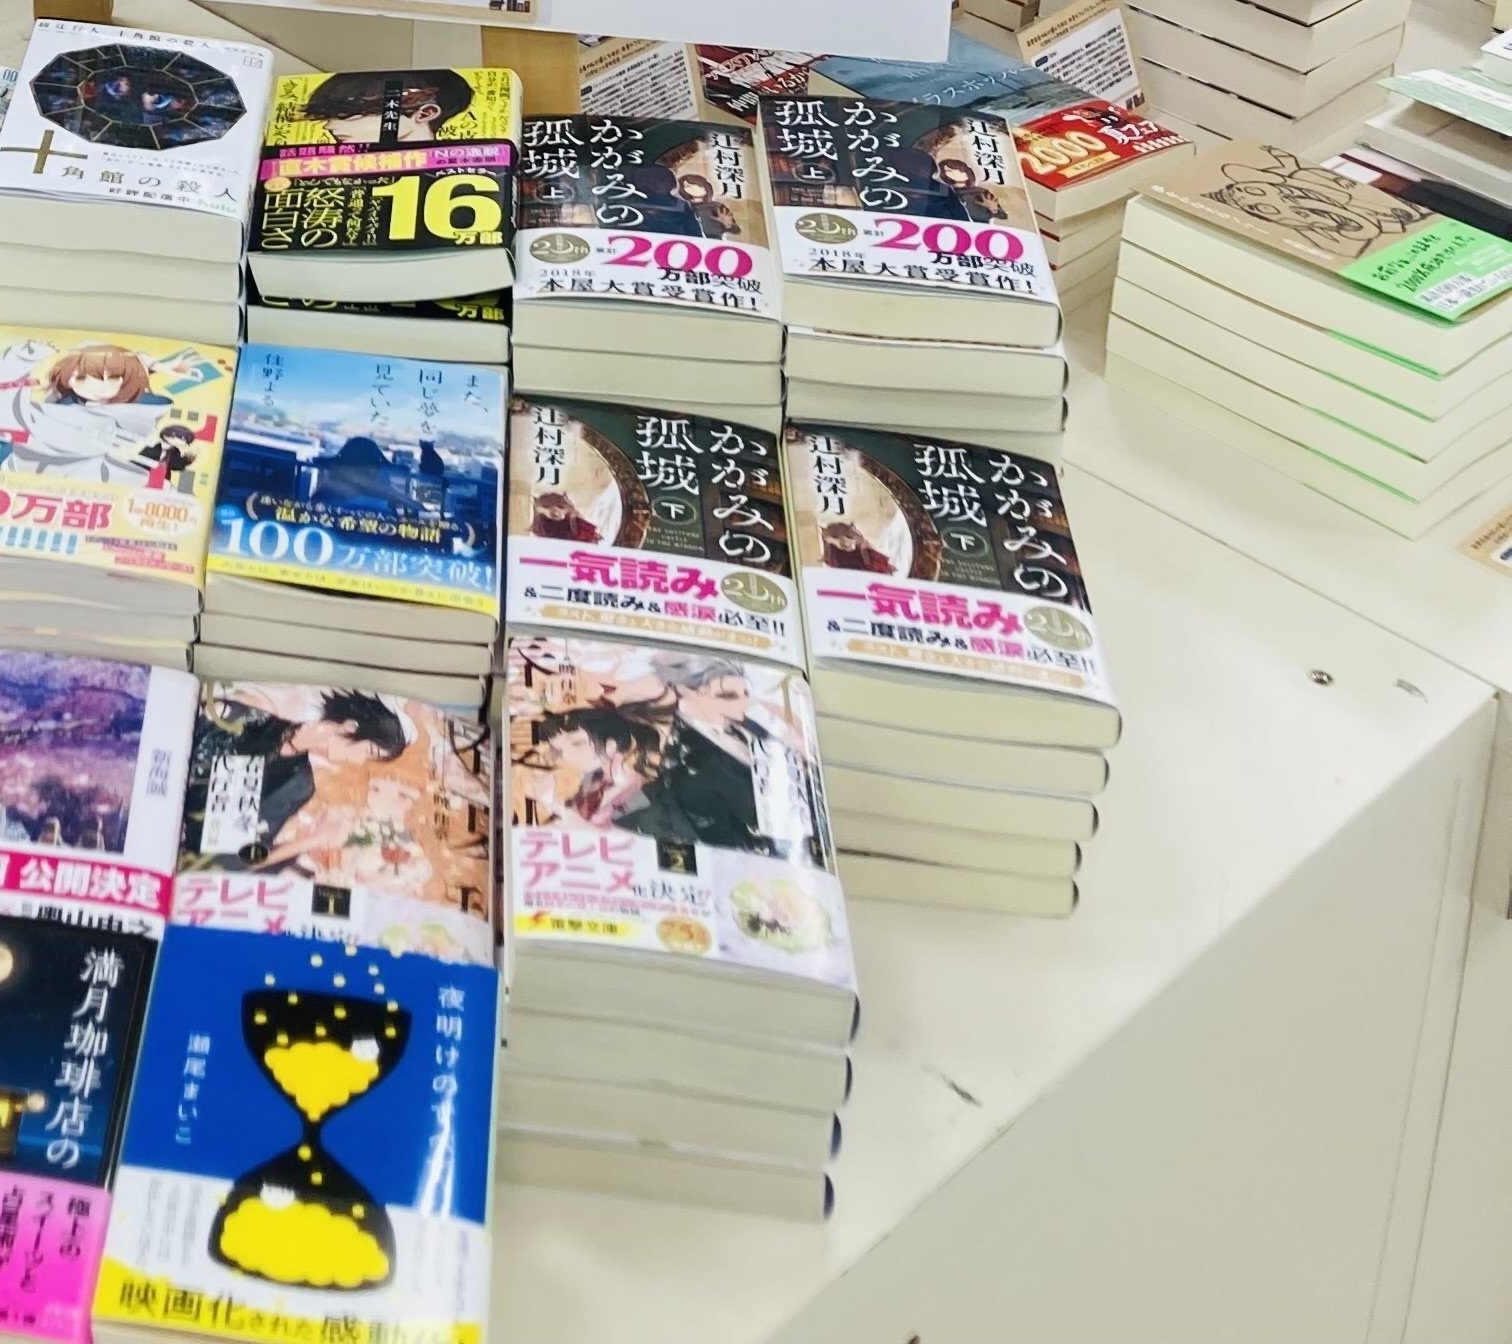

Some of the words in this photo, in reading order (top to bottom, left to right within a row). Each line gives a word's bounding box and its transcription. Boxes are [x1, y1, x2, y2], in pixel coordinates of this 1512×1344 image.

[522, 118, 584, 179] 孤城
[773, 99, 840, 161] 孤城
[845, 102, 908, 211] かがみの
[967, 118, 1005, 188] 辻村深月
[0, 129, 237, 202] 十角館の殺人
[279, 150, 427, 174] 直木賞候補作
[589, 119, 648, 228] かがみの
[710, 132, 746, 201] 辻村深月
[261, 187, 302, 249] 面白さ
[301, 187, 345, 249] 怒涛の
[372, 175, 502, 240] 16
[454, 231, 503, 245] 万部
[872, 215, 1024, 261] 200
[601, 233, 756, 279] 200
[658, 267, 762, 294] 万部突破
[810, 256, 1036, 295] 本屋大賞受賞作!
[929, 249, 1035, 279] 万部突破
[541, 277, 758, 313] 本屋大賞受賞作!
[530, 405, 571, 486] 辻村深月
[634, 417, 704, 496] 孤城
[808, 433, 851, 517] 辻村深月
[666, 503, 688, 521] 下
[710, 424, 775, 566] かがみの
[914, 444, 987, 529] 孤城
[220, 517, 494, 591] 100万部突破!
[951, 532, 974, 550] 下
[989, 454, 1070, 598] かがみの
[519, 553, 717, 602] 一気読み
[816, 583, 1024, 634] 一気読み
[520, 833, 634, 857] テレビ
[19, 856, 161, 908] 公開決定
[182, 878, 294, 910] テレビ
[522, 861, 634, 893] アニメ
[44, 944, 126, 1173] 満月珈琲店の
[174, 1033, 213, 1146] 瀬尾まいこ
